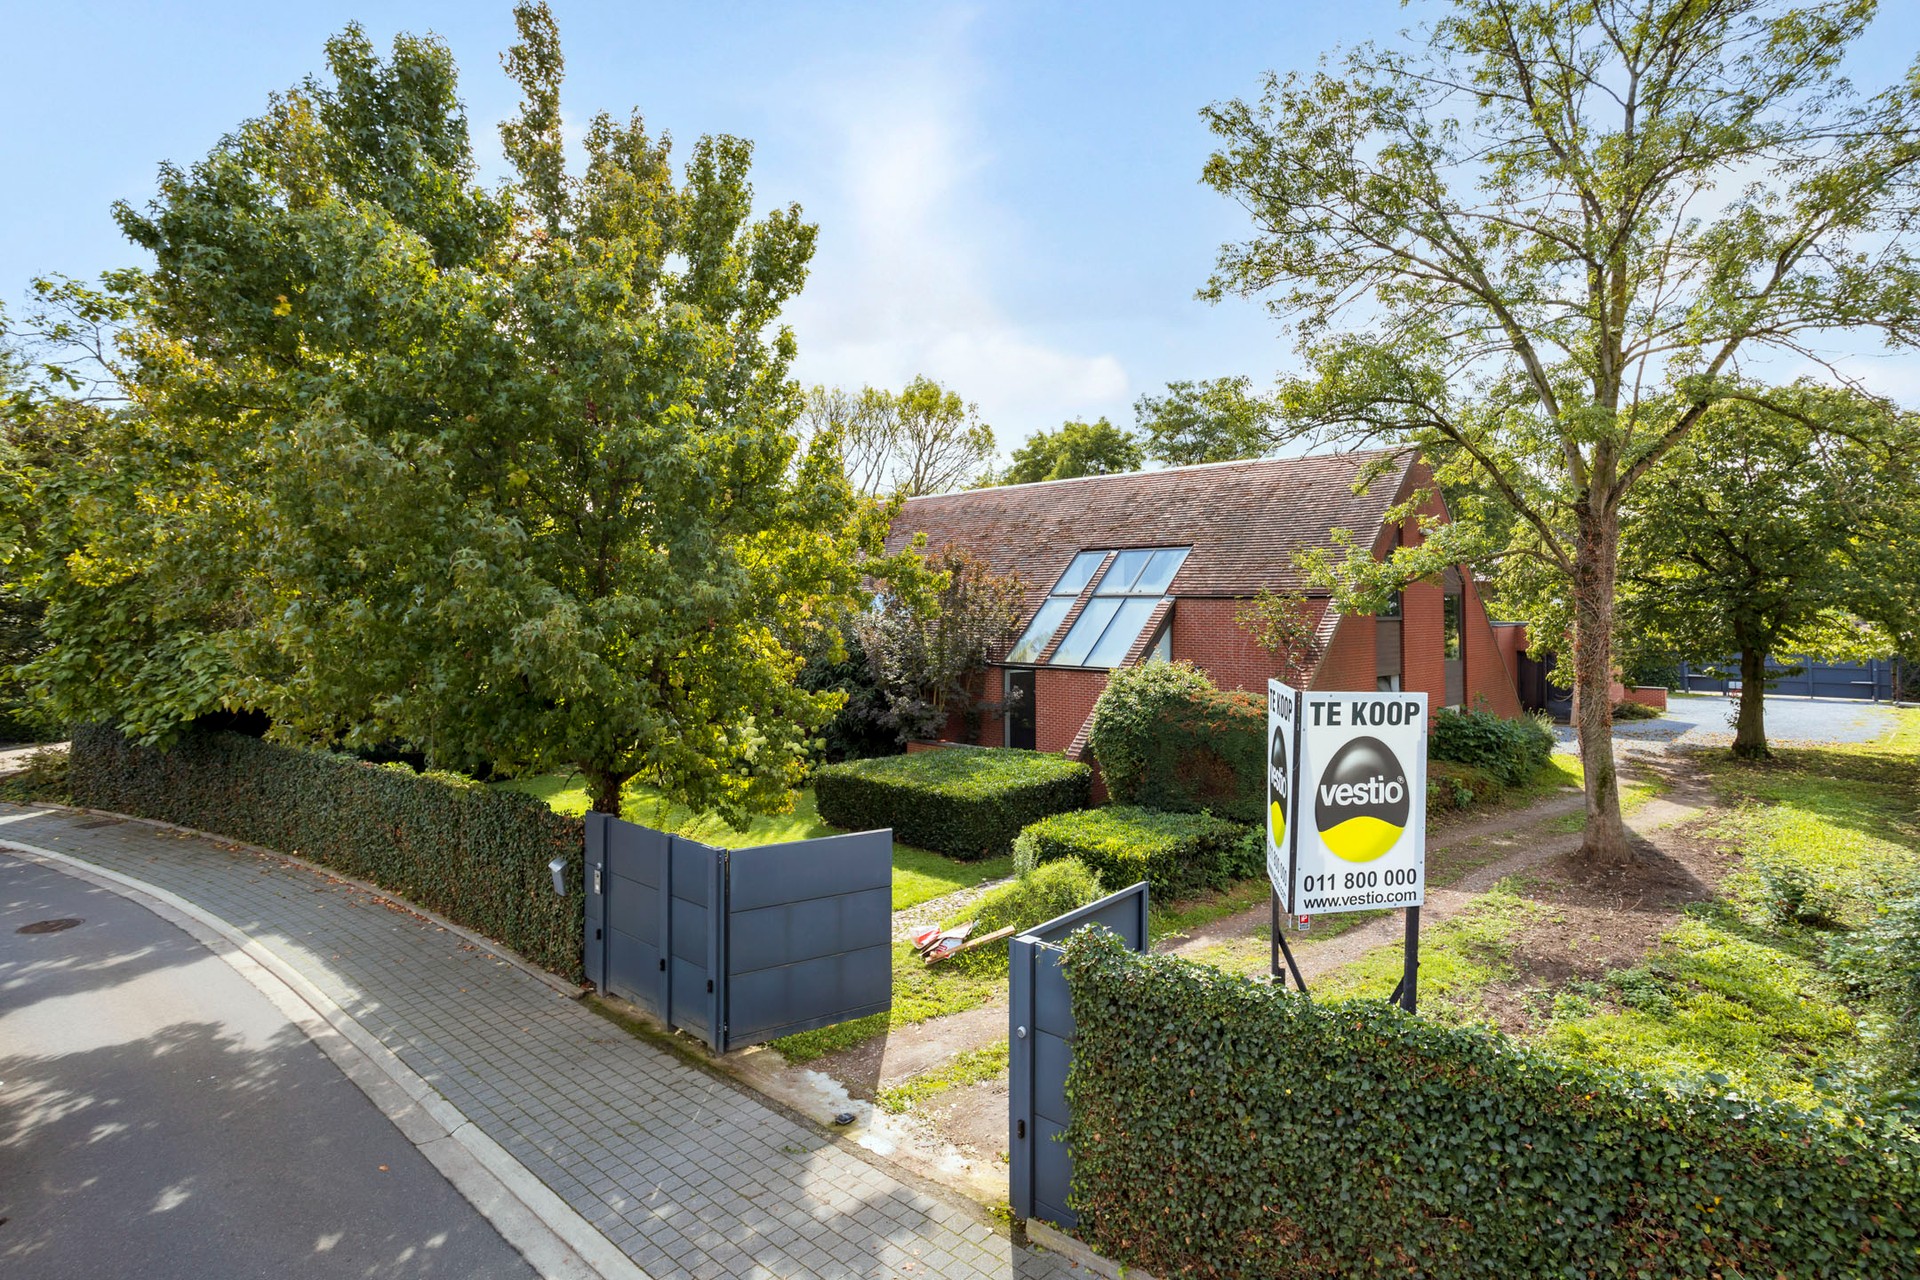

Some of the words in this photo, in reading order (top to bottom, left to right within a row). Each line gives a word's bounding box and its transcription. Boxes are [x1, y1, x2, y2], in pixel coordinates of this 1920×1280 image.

[1270, 688, 1276, 712] TE
[1277, 692, 1293, 722] KOOP
[1310, 702, 1341, 726] TE
[1351, 701, 1420, 726] KOOP
[1303, 875, 1335, 892] 011
[1344, 871, 1377, 889] 800
[1384, 868, 1417, 886] 000
[1303, 890, 1417, 909] www.vestio.com
